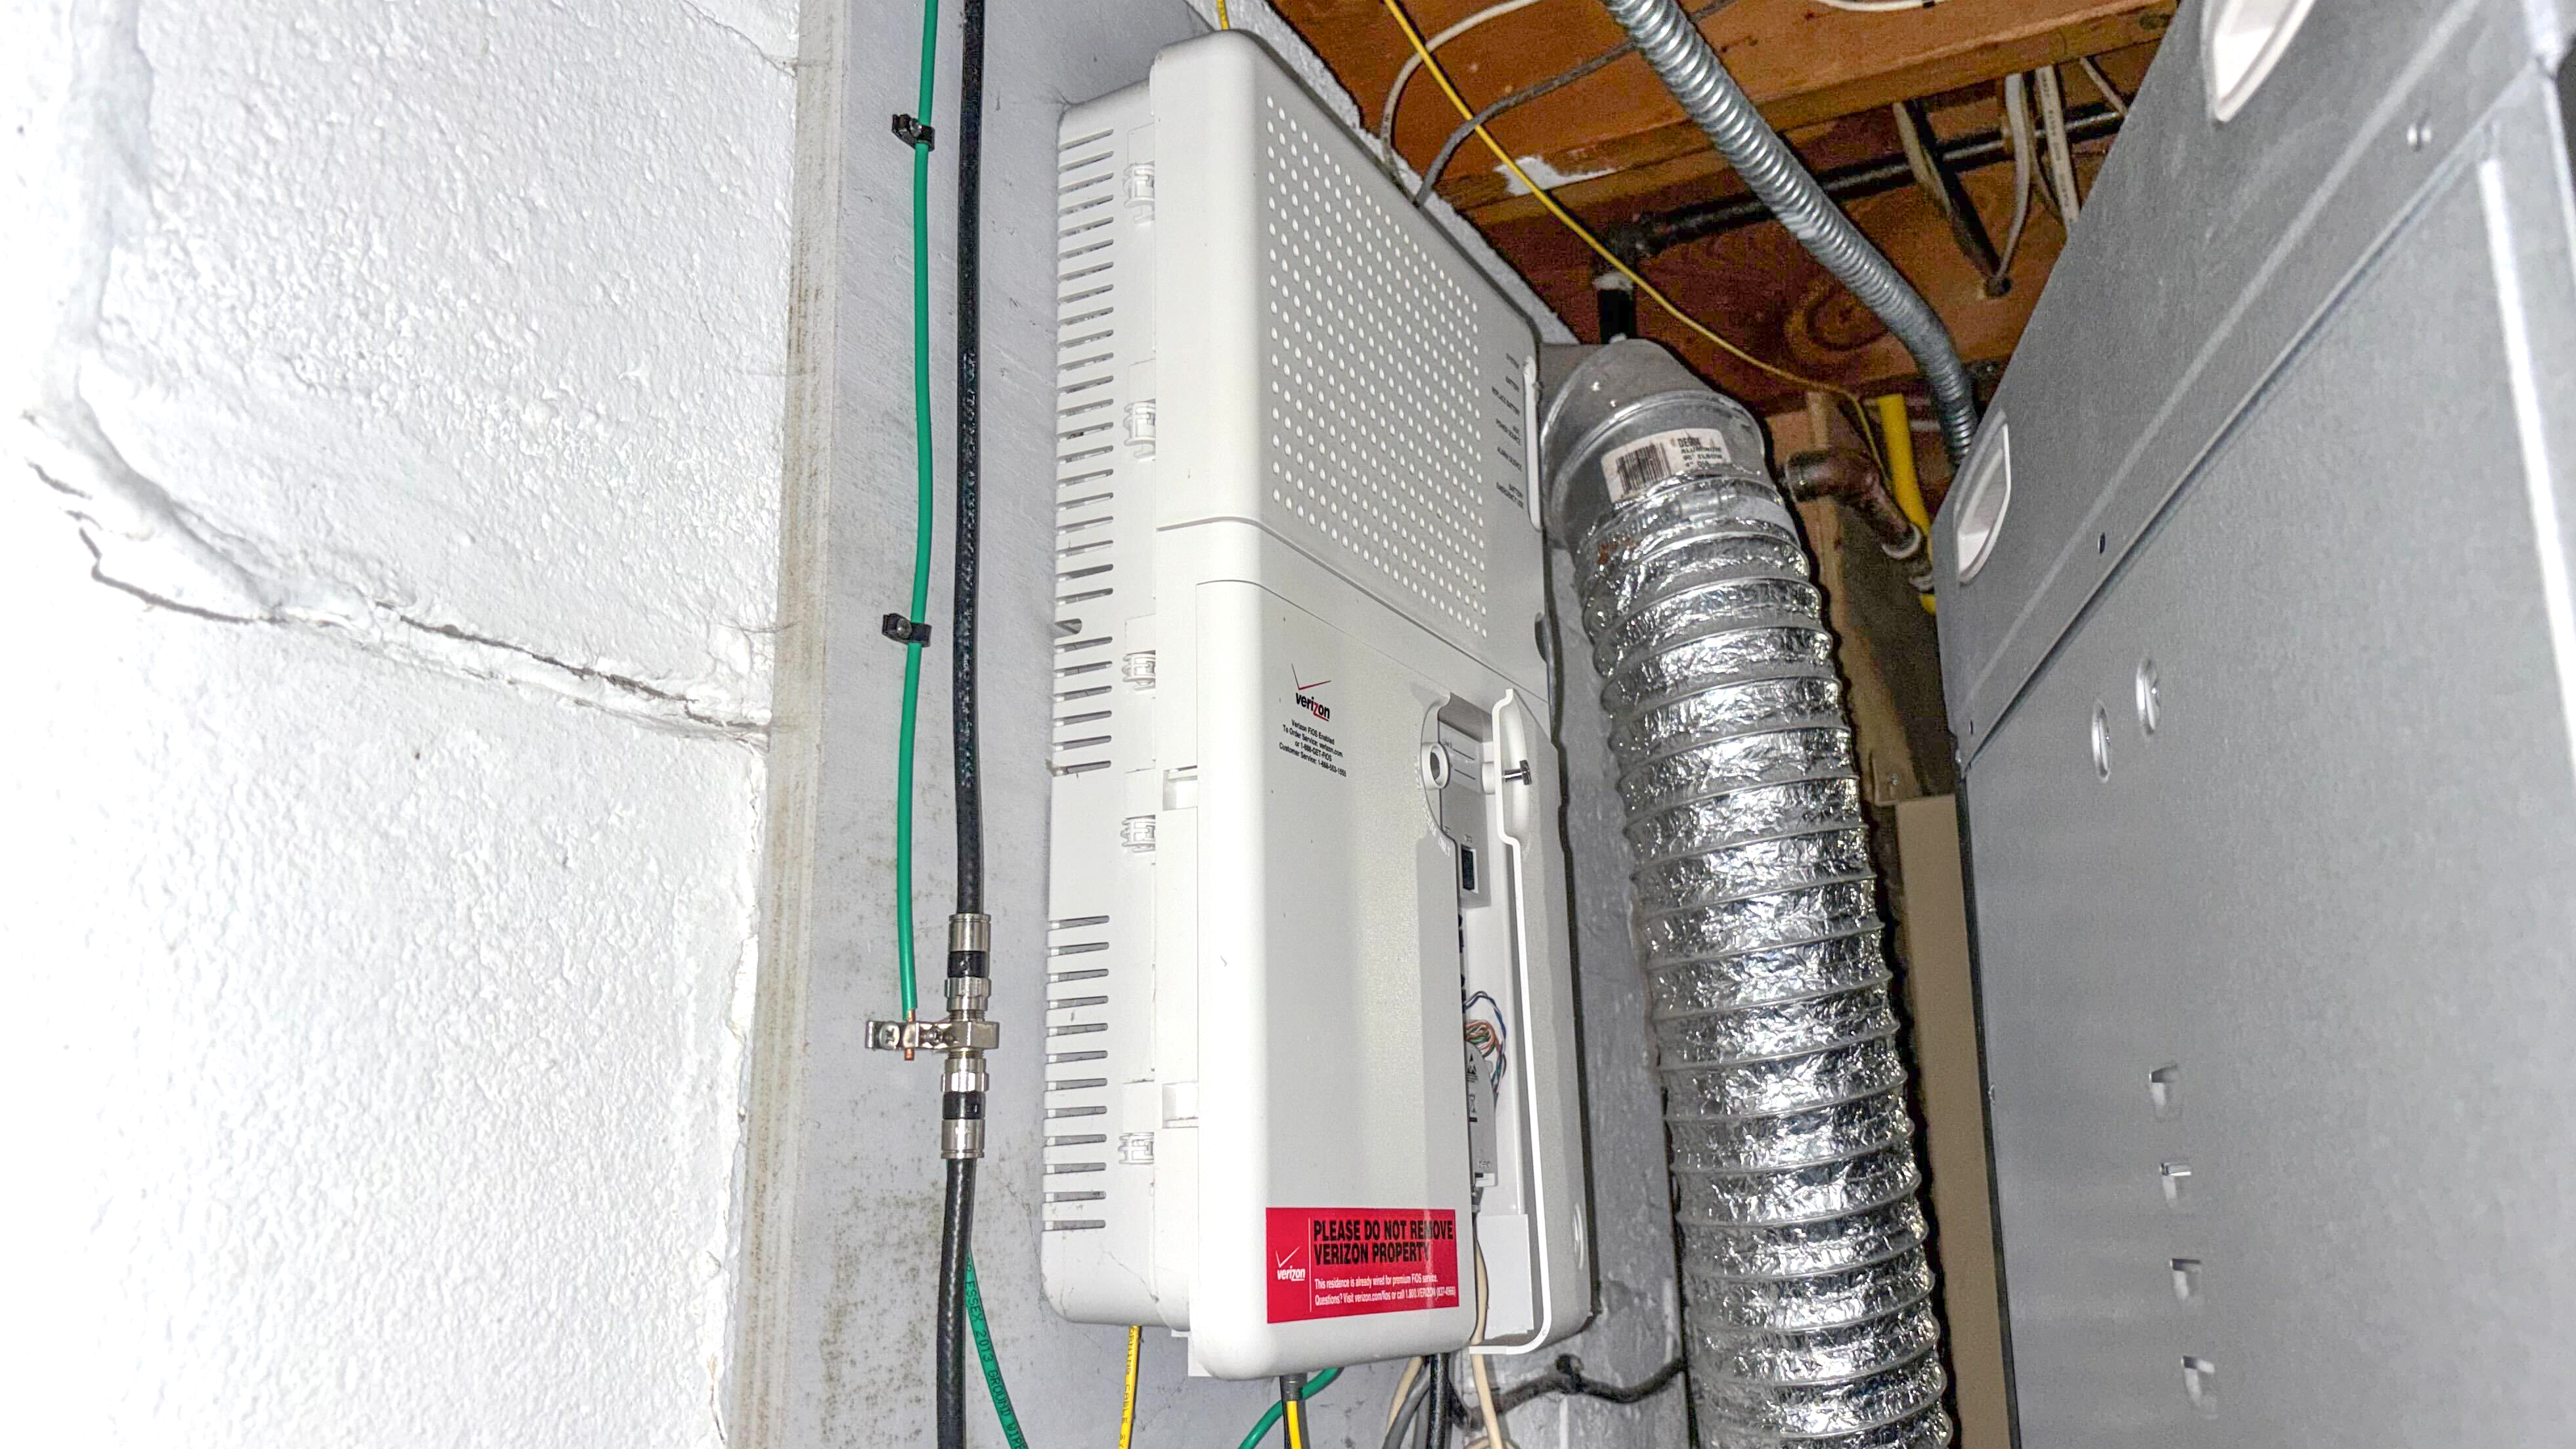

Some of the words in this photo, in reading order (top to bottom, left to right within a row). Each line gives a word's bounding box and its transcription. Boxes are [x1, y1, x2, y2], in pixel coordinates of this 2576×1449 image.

[1295, 692, 1330, 722] verizon
[1314, 1220, 1360, 1241] PLEASE
[1364, 1220, 1381, 1241] DO
[1385, 1220, 1407, 1240] NOT
[1410, 1220, 1454, 1240] REMOVE
[1314, 1242, 1369, 1266] VERIZON
[1372, 1241, 1430, 1264] PROPERTY
[1277, 1265, 1306, 1282] verizon
[1314, 1278, 1325, 1289] This
[1326, 1277, 1350, 1289] residence
[1350, 1276, 1355, 1287] is
[1355, 1276, 1372, 1289] already
[1373, 1276, 1385, 1286] wired
[1392, 1274, 1411, 1287] premium
[1422, 1274, 1438, 1284] service.
[1315, 1293, 1343, 1306] Questions?
[1343, 1291, 1354, 1304] Visit
[1392, 1291, 1396, 1301] or
[1396, 1289, 1405, 1300] call
[966, 1281, 984, 1321] ESSEX
[975, 1330, 994, 1362] 2013
[987, 1369, 1011, 1416] GROUND
[1126, 1326, 1134, 1375] ORNING
